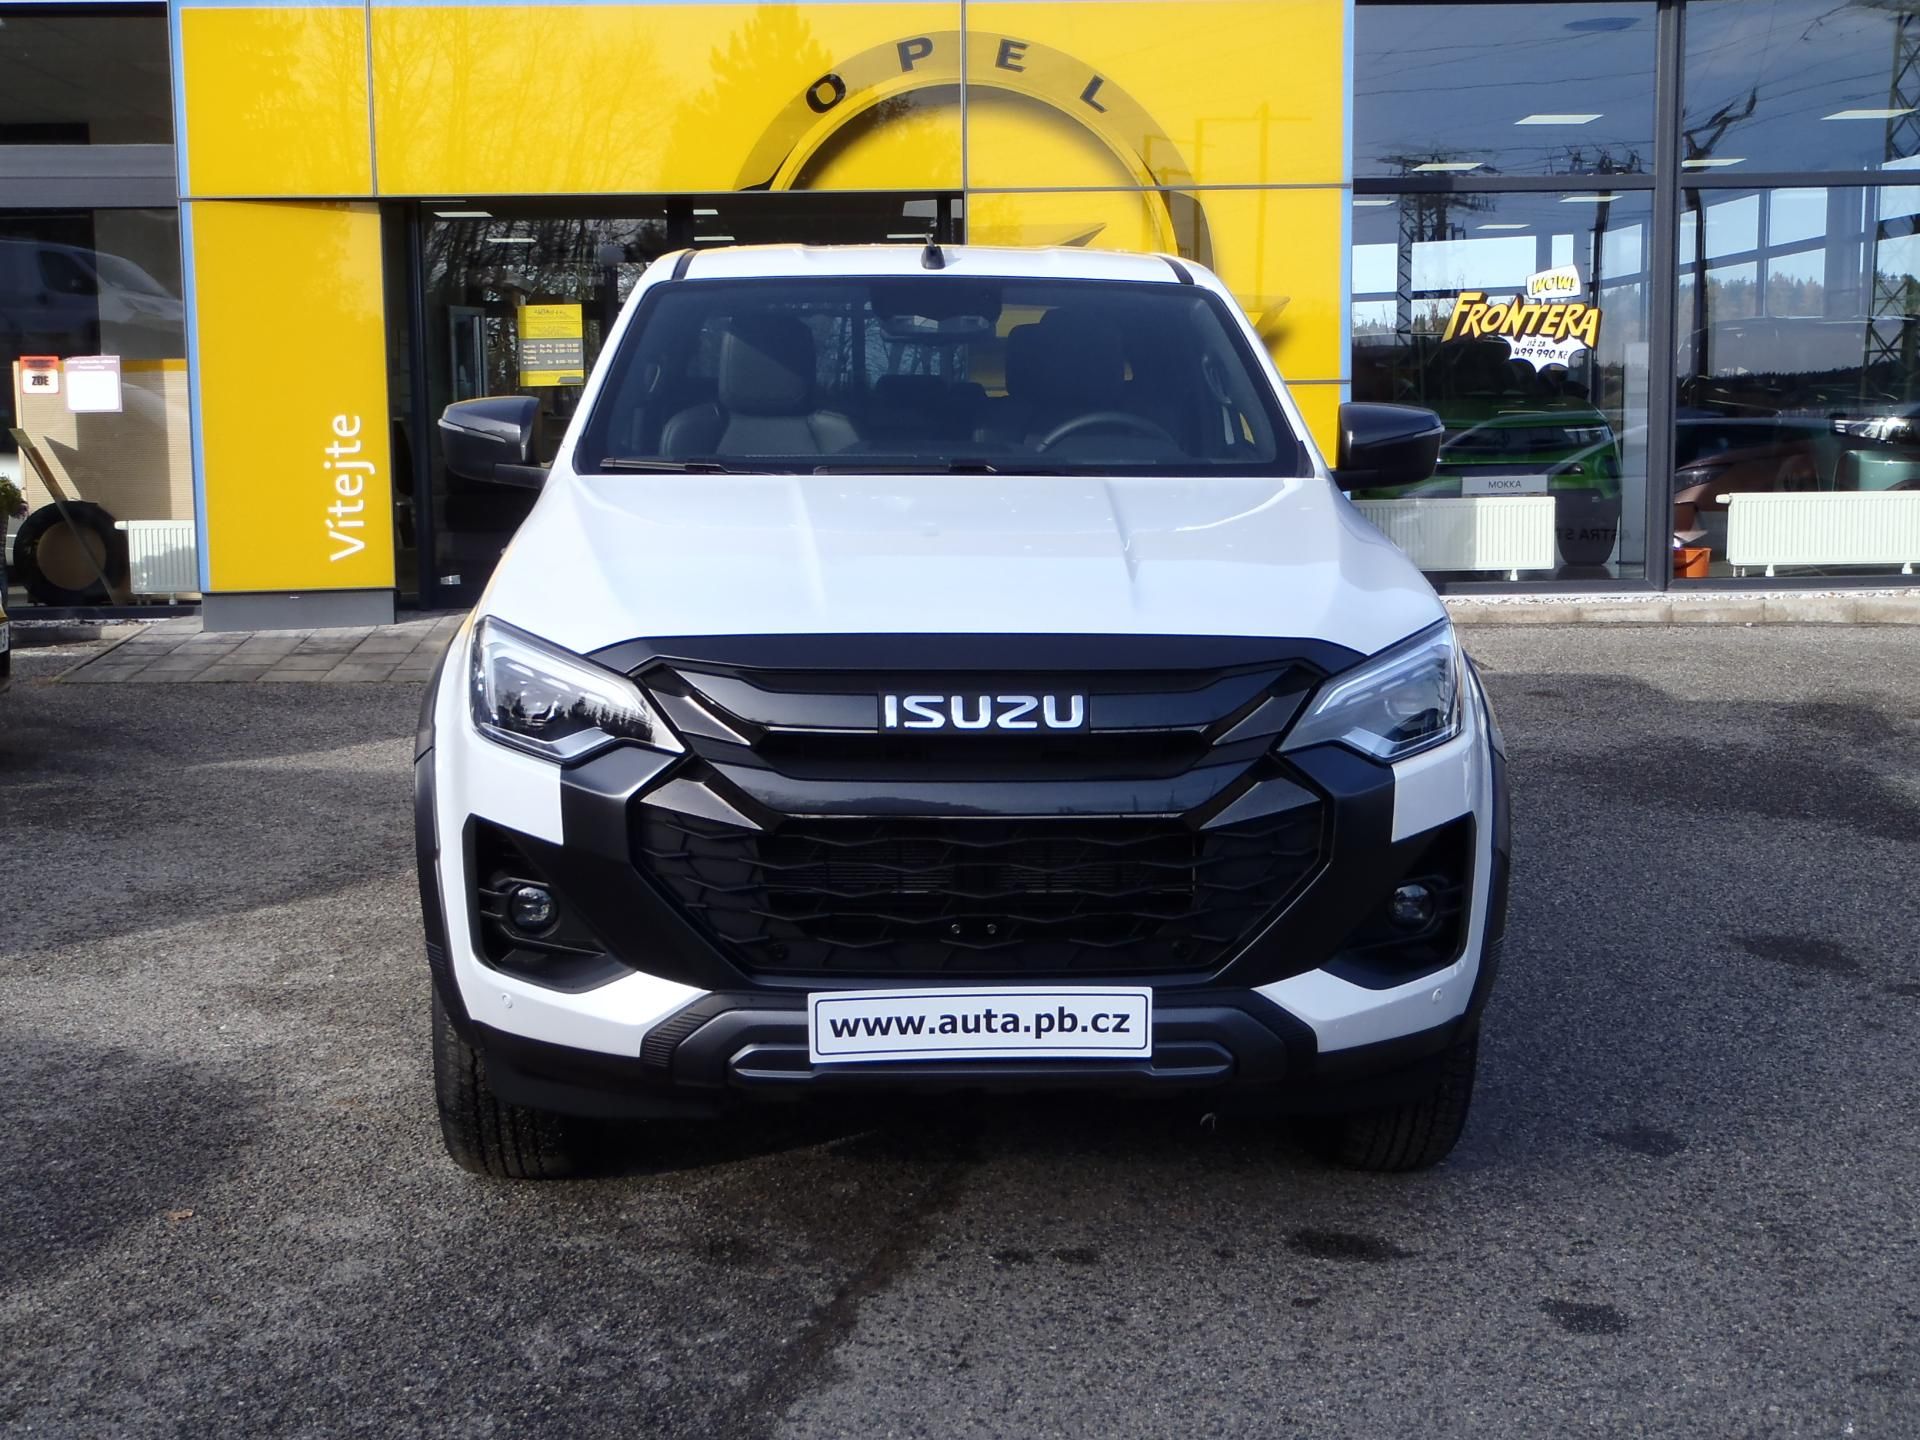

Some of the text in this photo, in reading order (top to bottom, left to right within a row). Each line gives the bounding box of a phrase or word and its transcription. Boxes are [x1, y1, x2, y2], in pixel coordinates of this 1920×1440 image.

[805, 36, 1109, 114] OPEL
[1531, 275, 1574, 295] WOW!
[1441, 291, 1602, 349] FRONTERA
[1514, 347, 1534, 358] 499
[1536, 348, 1556, 359] 990
[323, 413, 376, 562] Vítejte
[1488, 480, 1522, 489] MOKKA
[884, 694, 1084, 729] ISUZU
[829, 1006, 1131, 1040] www.auta.pb.cz
